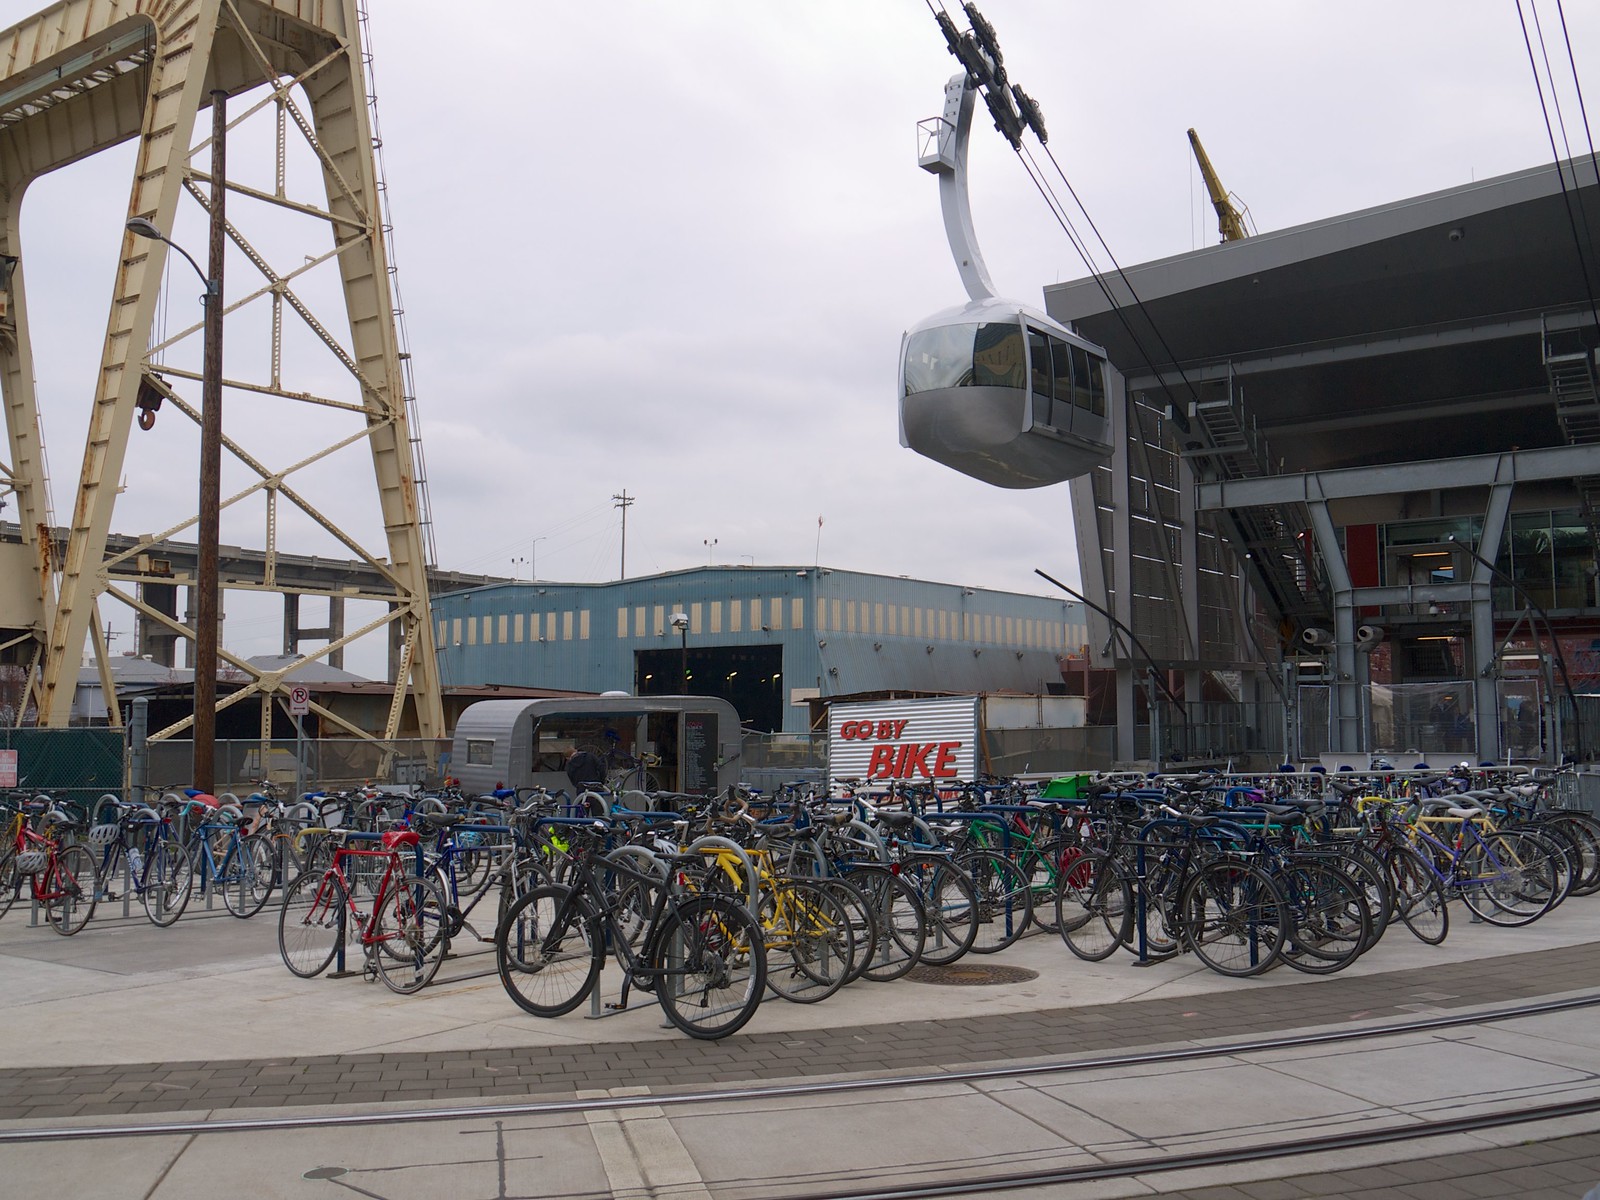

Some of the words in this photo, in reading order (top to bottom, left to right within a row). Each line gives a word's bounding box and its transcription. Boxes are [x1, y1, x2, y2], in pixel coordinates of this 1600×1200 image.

[840, 720, 873, 739] GO
[876, 719, 907, 739] BY
[867, 741, 961, 778] BIKE
